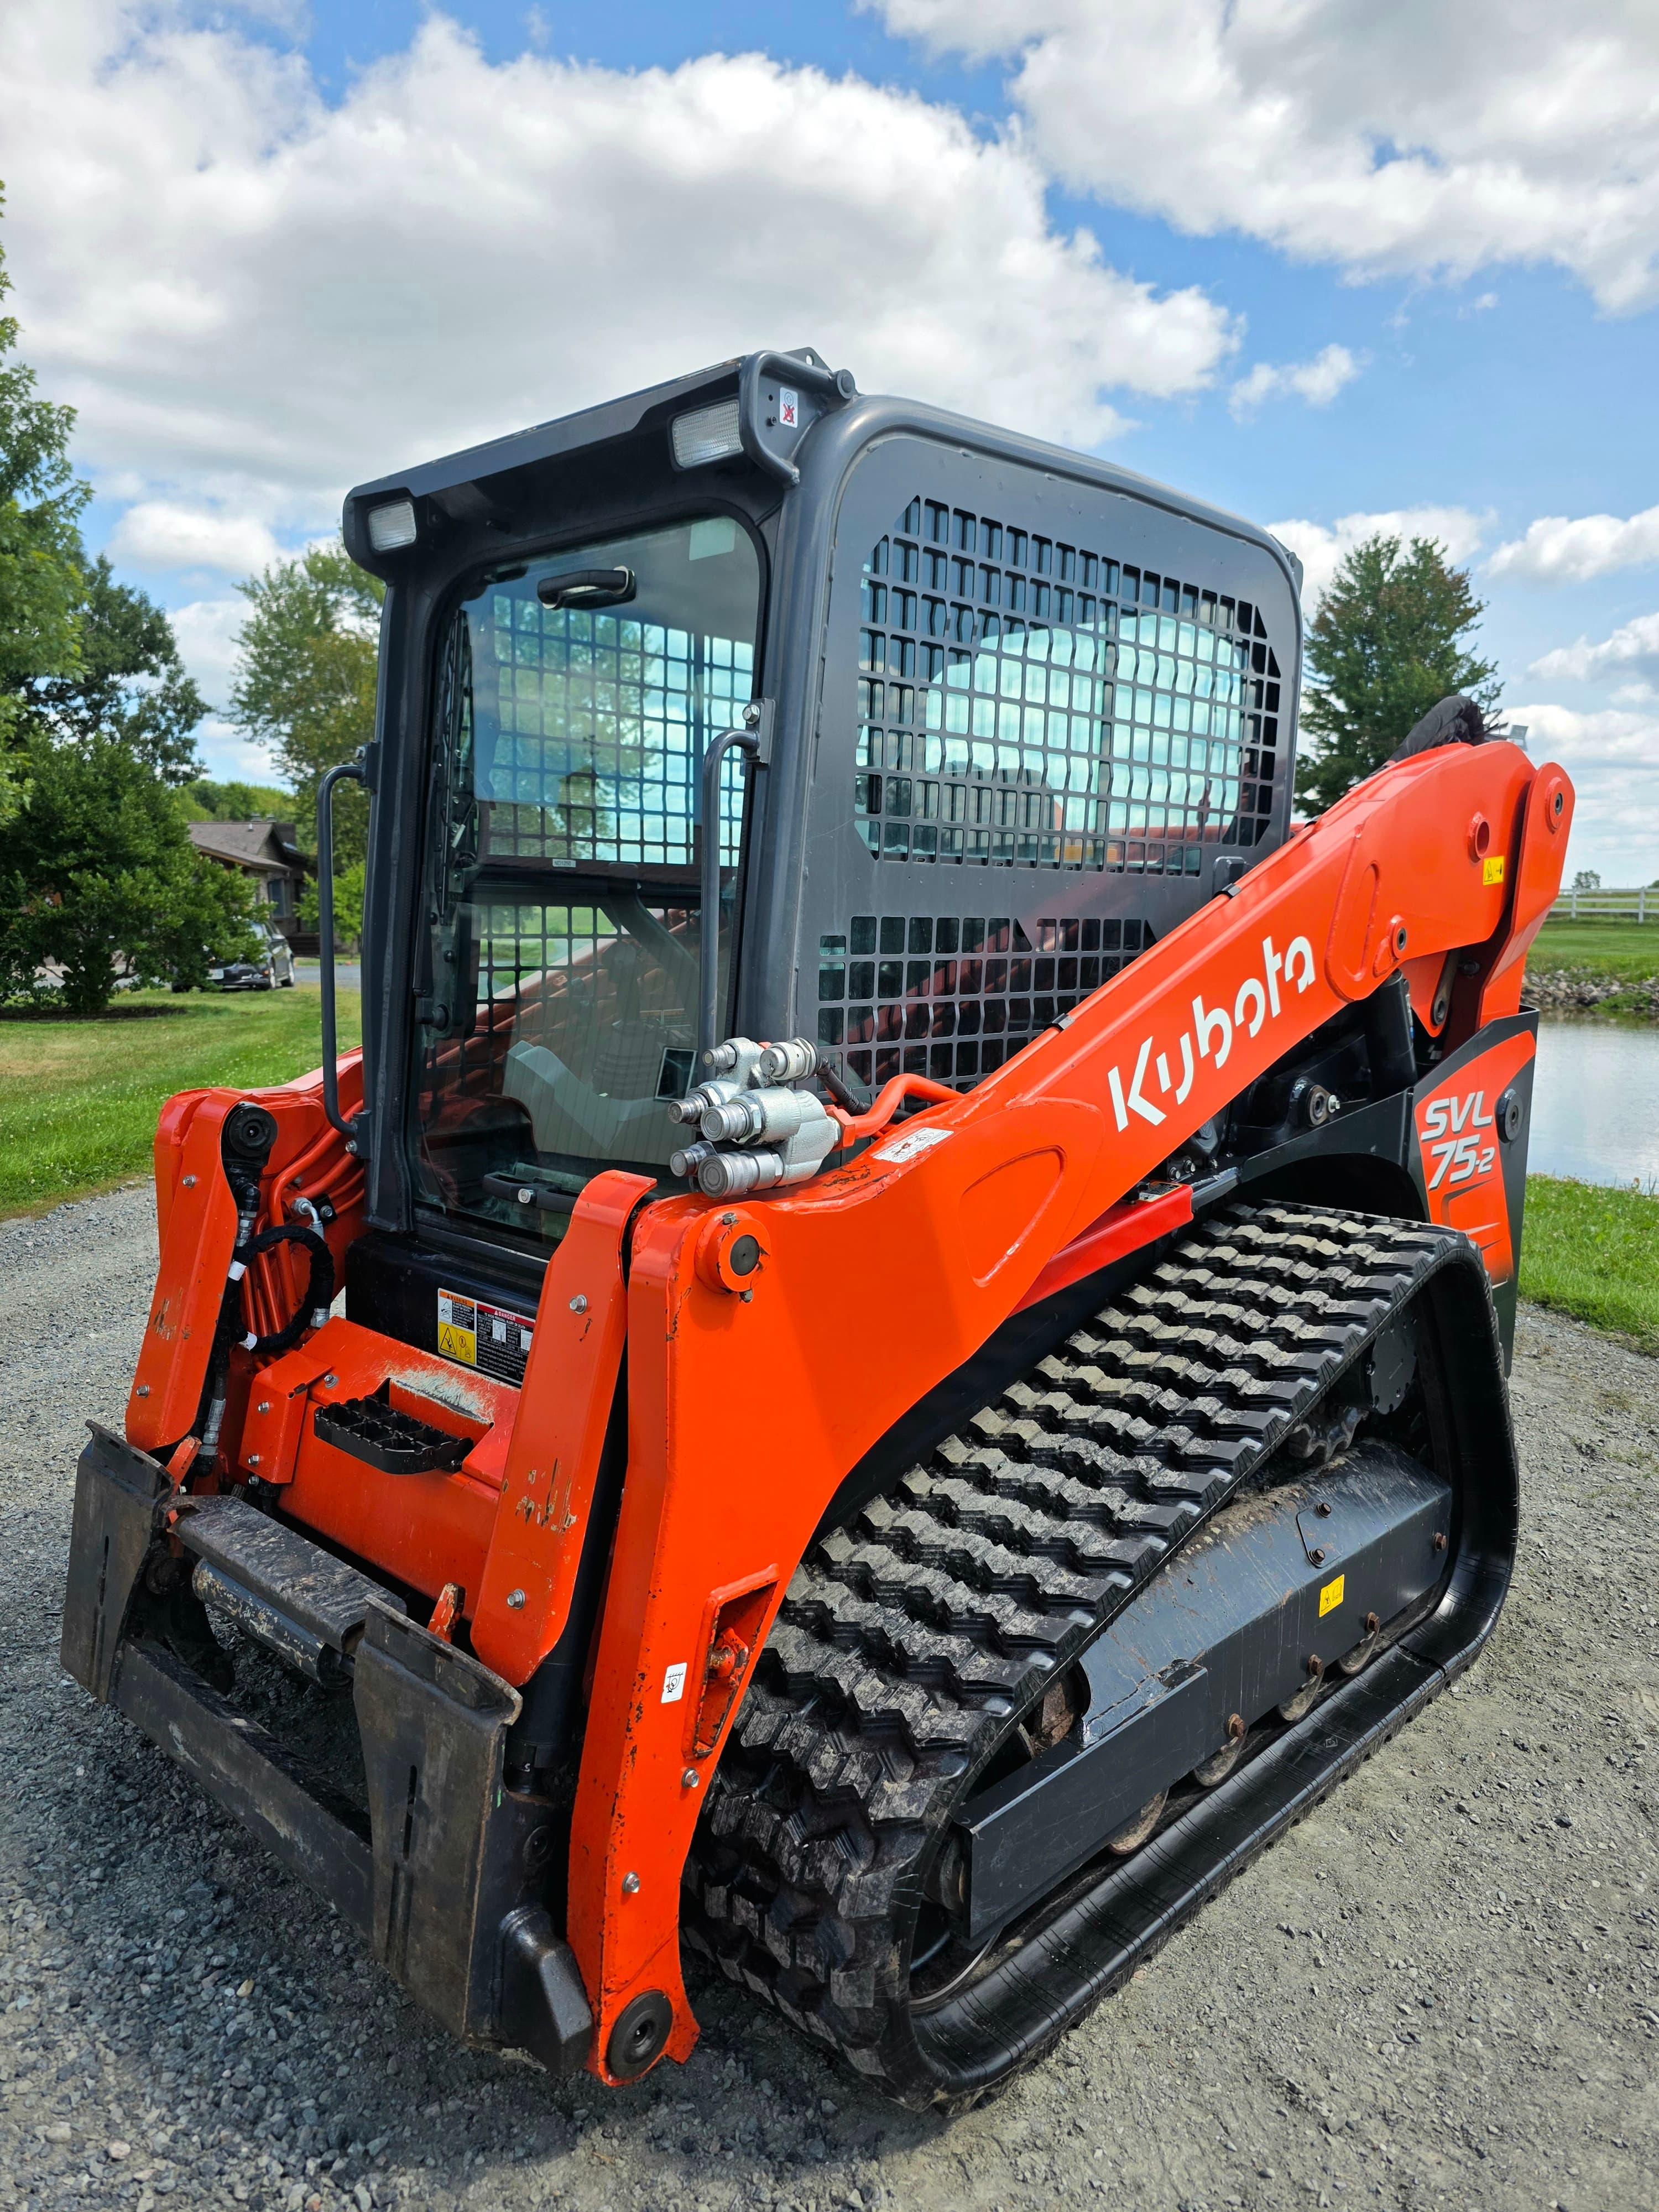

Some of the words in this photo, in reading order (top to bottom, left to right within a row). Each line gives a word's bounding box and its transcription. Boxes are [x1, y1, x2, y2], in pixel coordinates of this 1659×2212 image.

[1108, 936, 1316, 1133] Kubota
[1420, 1091, 1493, 1142] SVL
[1428, 1134, 1495, 1191] 75-2
[499, 1311, 516, 1321] DANGER
